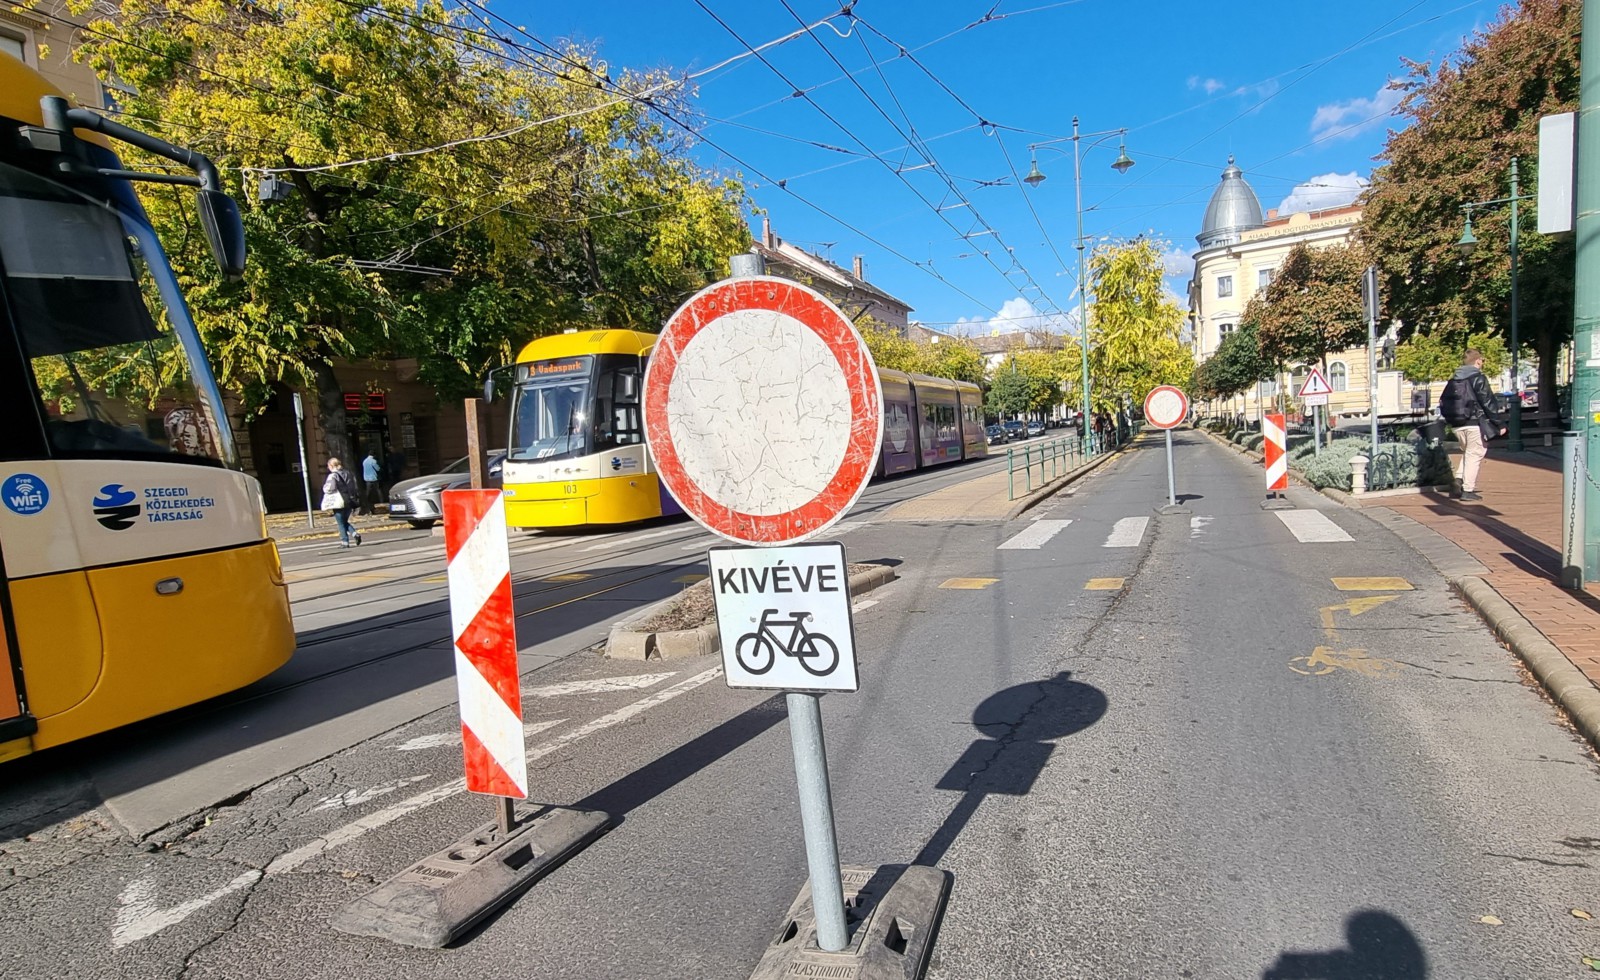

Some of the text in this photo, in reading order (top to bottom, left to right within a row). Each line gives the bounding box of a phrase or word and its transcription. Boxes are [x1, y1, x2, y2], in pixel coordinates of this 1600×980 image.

[144, 487, 188, 498] SZEGEDI
[563, 485, 577, 494] 103
[146, 496, 215, 510] KÖZLEKEDÉSI
[147, 509, 203, 522] TÁRSASÁG
[718, 560, 838, 594] KIVÉVE
